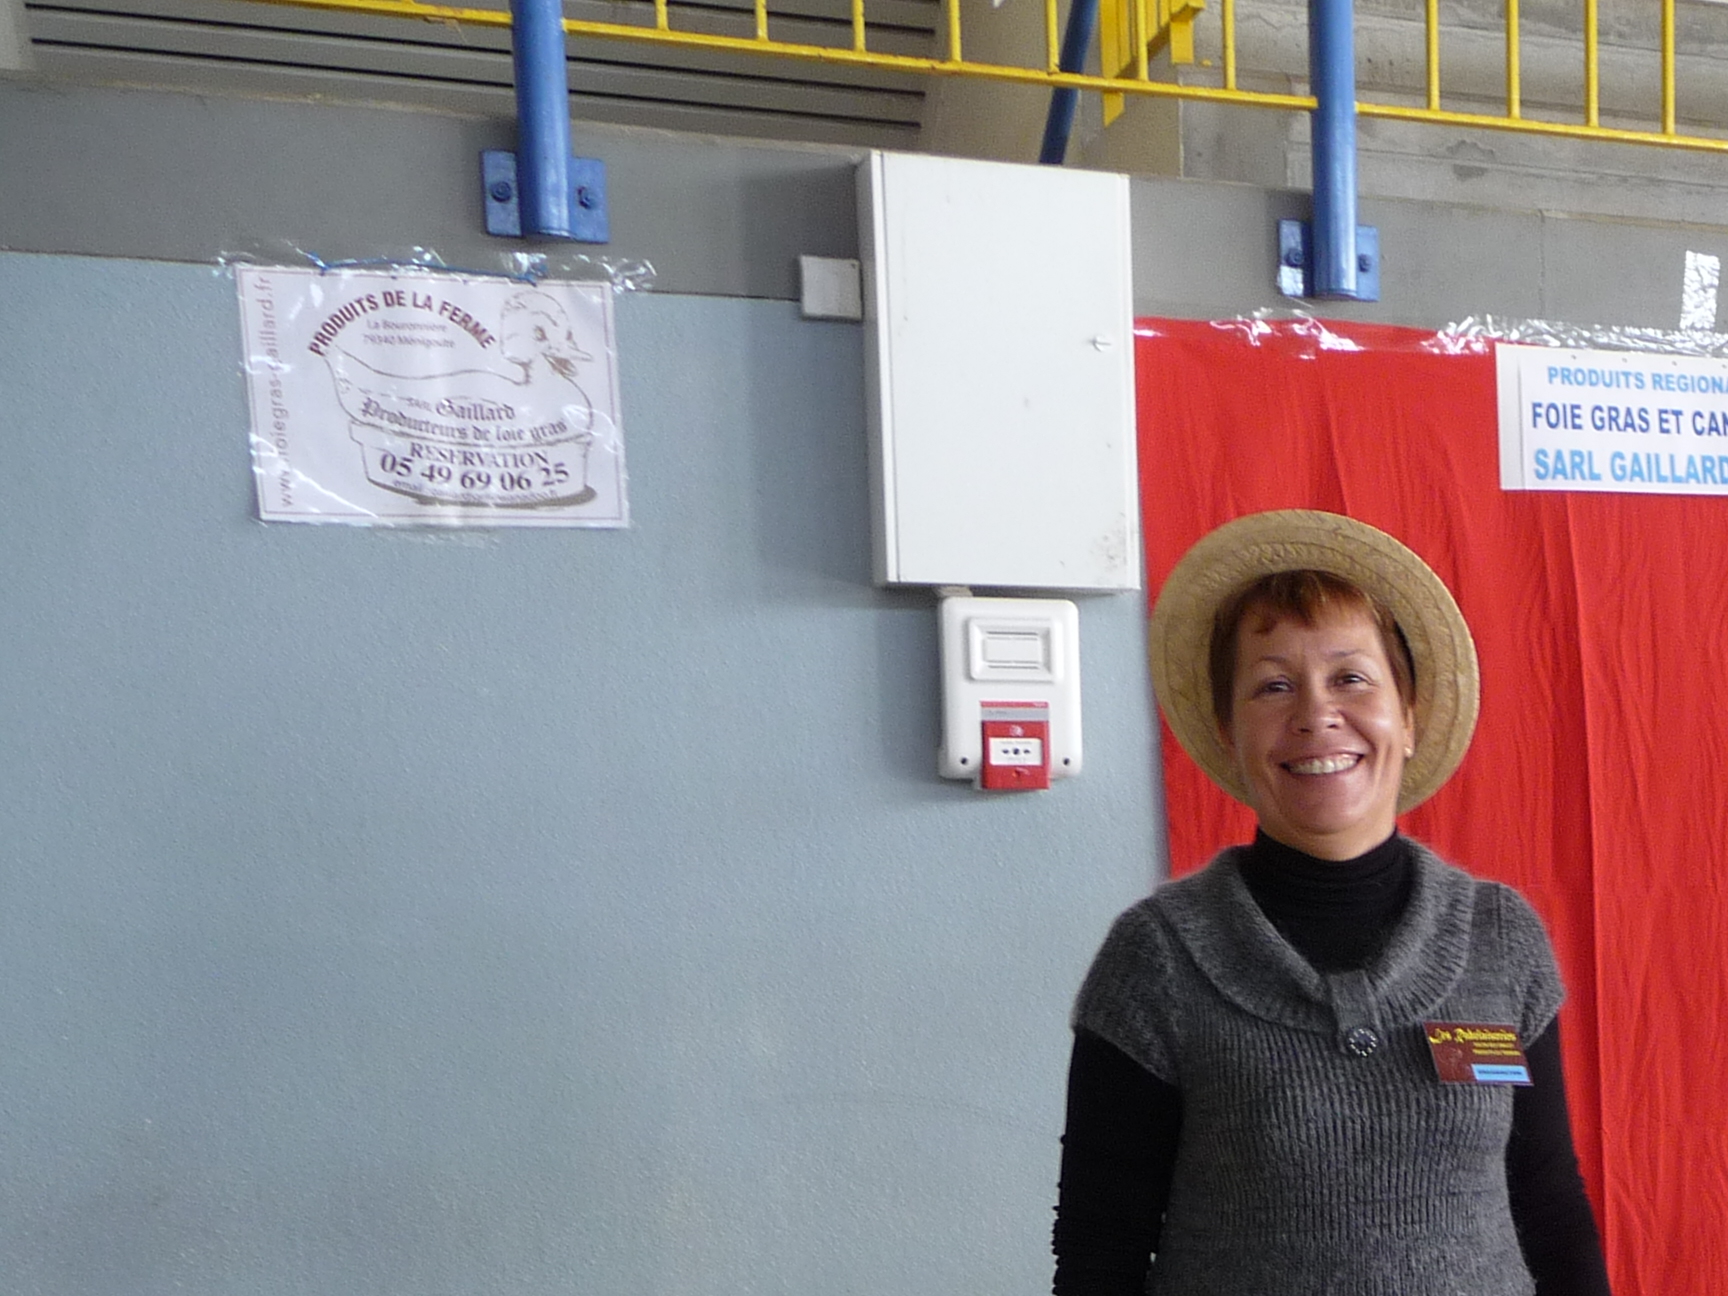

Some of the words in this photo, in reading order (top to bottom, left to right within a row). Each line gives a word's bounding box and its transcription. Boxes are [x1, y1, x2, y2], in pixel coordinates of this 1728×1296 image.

[307, 293, 380, 357] PRODUITS
[382, 290, 406, 308] DE
[412, 291, 433, 311] LA
[439, 301, 497, 349] FERME
[1547, 366, 1646, 390] PRODUITS
[361, 396, 470, 440] Producteurs
[471, 424, 491, 441] de
[529, 417, 568, 444] gras
[435, 399, 516, 422] Gaillard
[1532, 402, 1583, 431] FOIE
[1591, 405, 1651, 433] GRAS
[1659, 408, 1684, 434] ET
[410, 441, 550, 469] RESERVATION
[1533, 448, 1603, 482] SARL
[380, 453, 413, 477] 05
[420, 463, 453, 483] 49
[460, 469, 491, 490] 69
[500, 470, 532, 492] 06
[539, 462, 570, 487] 25
